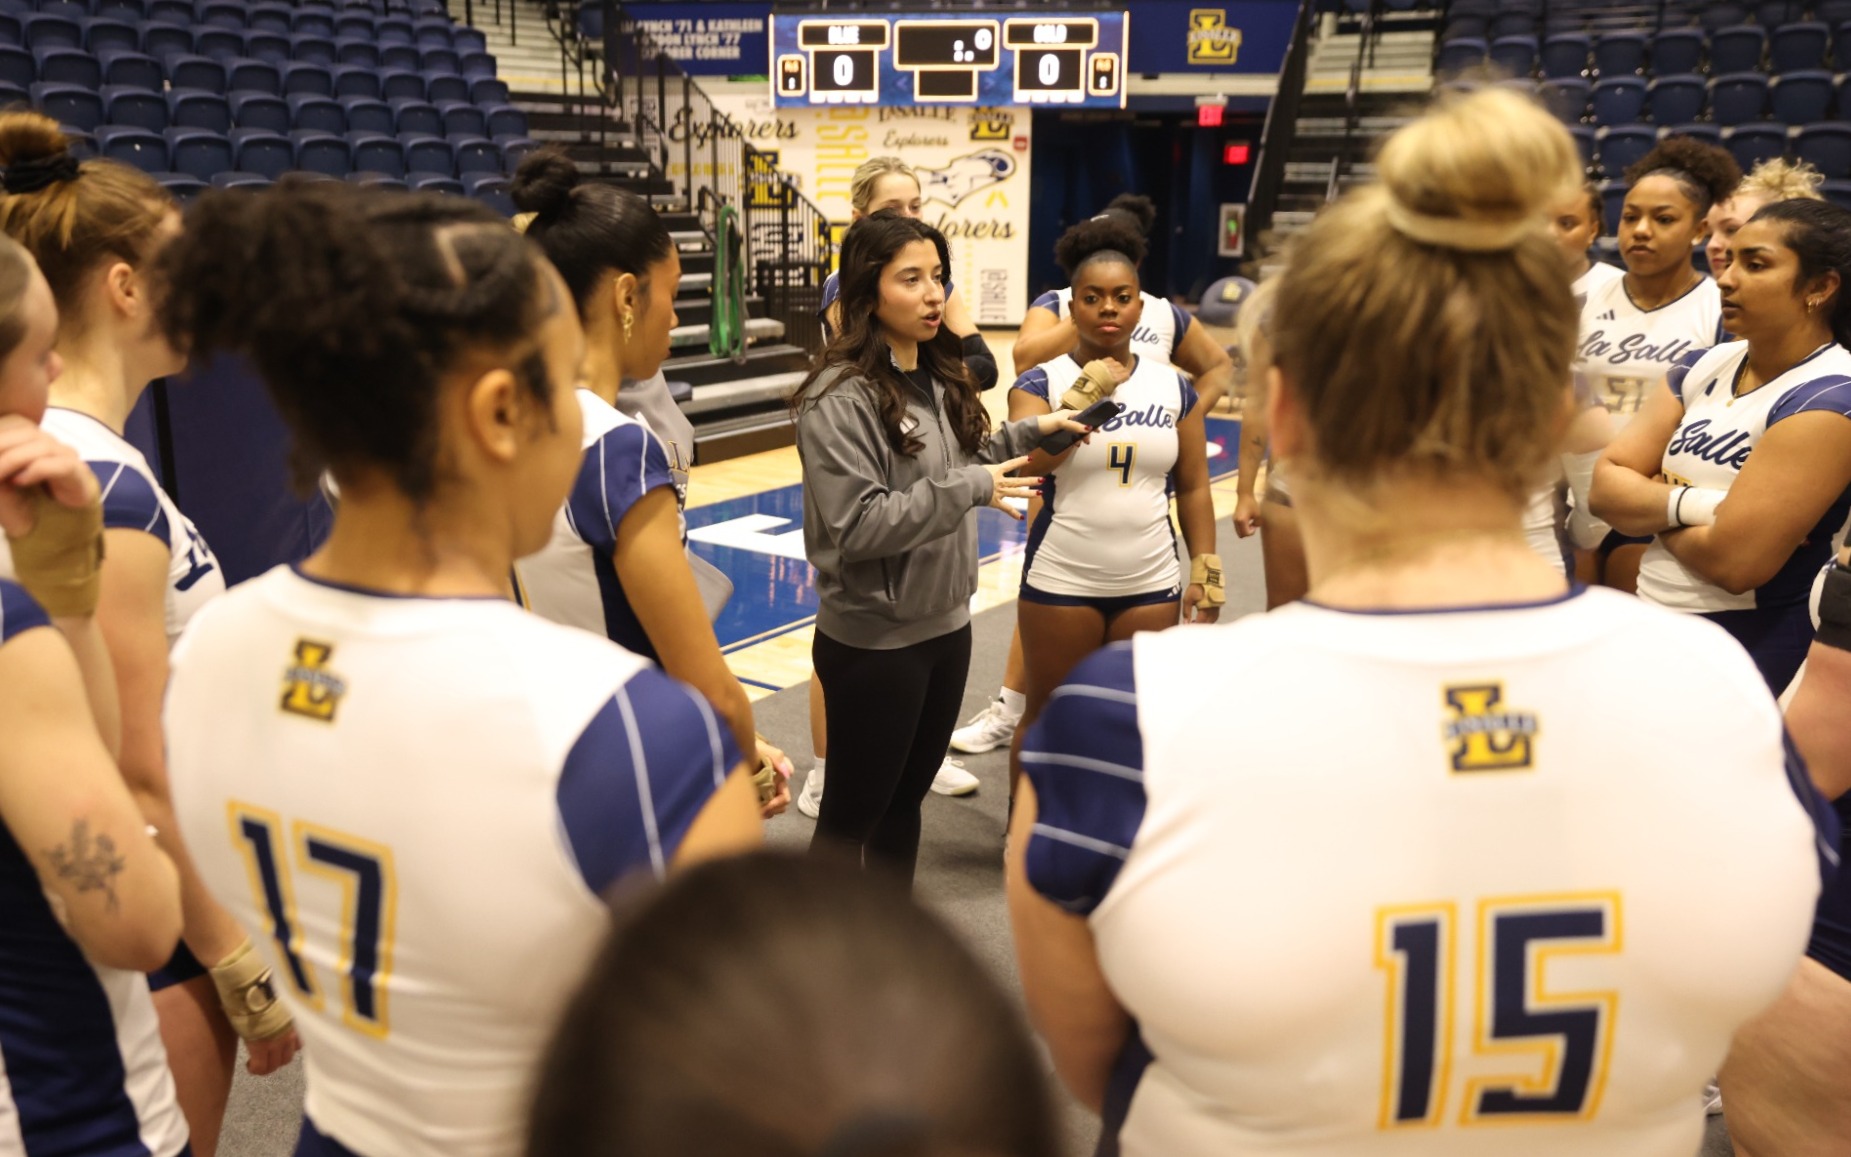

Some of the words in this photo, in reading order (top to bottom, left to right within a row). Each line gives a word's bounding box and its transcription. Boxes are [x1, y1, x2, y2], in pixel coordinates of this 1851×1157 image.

[684, 33, 719, 45] LYNCH
[708, 19, 763, 32] KATHLEEN
[696, 46, 740, 59] CORNER
[833, 54, 854, 86] 0
[1038, 53, 1060, 86] 0
[1106, 442, 1138, 488] 4
[226, 800, 397, 1039] 17
[1374, 889, 1624, 1130] 15
